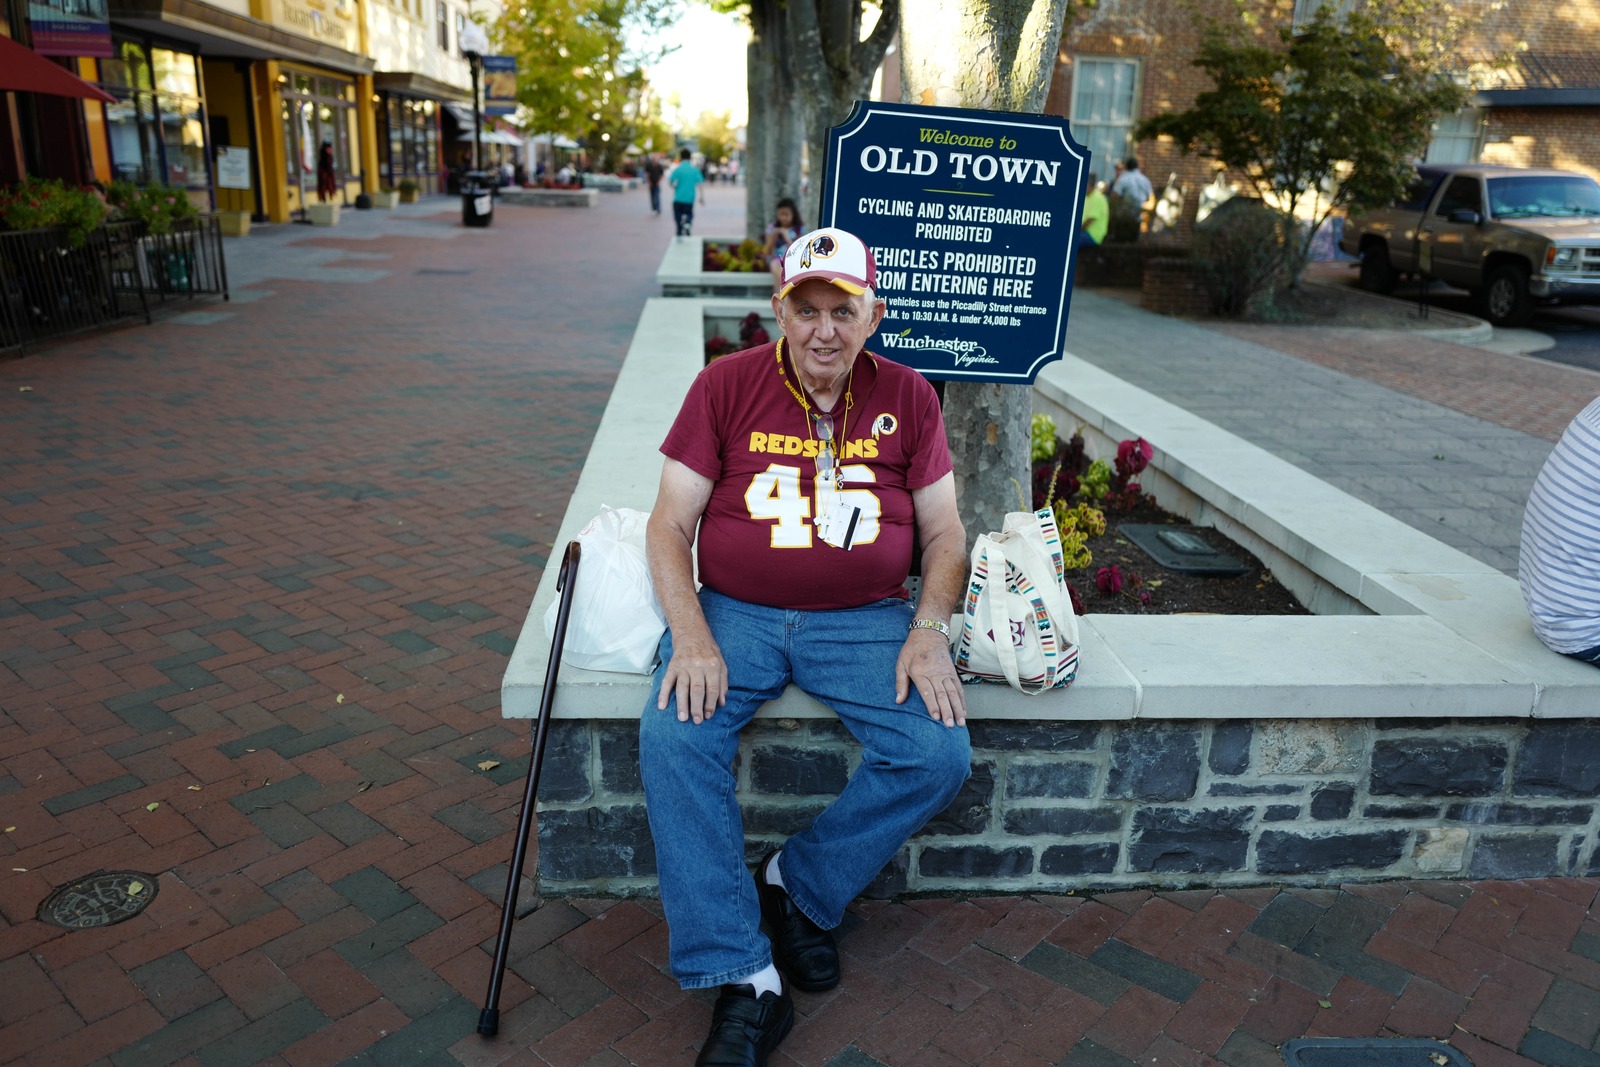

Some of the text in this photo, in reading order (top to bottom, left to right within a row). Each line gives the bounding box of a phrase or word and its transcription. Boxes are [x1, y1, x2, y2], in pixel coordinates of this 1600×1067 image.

[919, 128, 1017, 150] Welcome to
[860, 145, 1061, 187] OLD TOWN
[858, 198, 1052, 227] CYCLING AND SKATEBOARDING
[915, 223, 992, 243] PROHIBITED
[943, 252, 1037, 276] PROHIBITED
[875, 271, 1034, 298] ROM ENTERING HERE
[888, 297, 920, 308] vehicles
[921, 300, 936, 309] use
[937, 300, 950, 309] the
[951, 301, 988, 313] Piccadilly
[989, 302, 1012, 313] Street
[1013, 305, 1047, 315] entrance
[902, 311, 910, 320] to
[912, 311, 932, 321] 10:30
[933, 313, 950, 322] A.M.
[952, 315, 958, 323] &
[960, 315, 981, 324] under
[982, 316, 1008, 326] 24,000
[1010, 317, 1021, 327] lbs
[880, 332, 979, 352] Winchester
[954, 351, 999, 367] Virginia
[744, 463, 882, 548] 46
